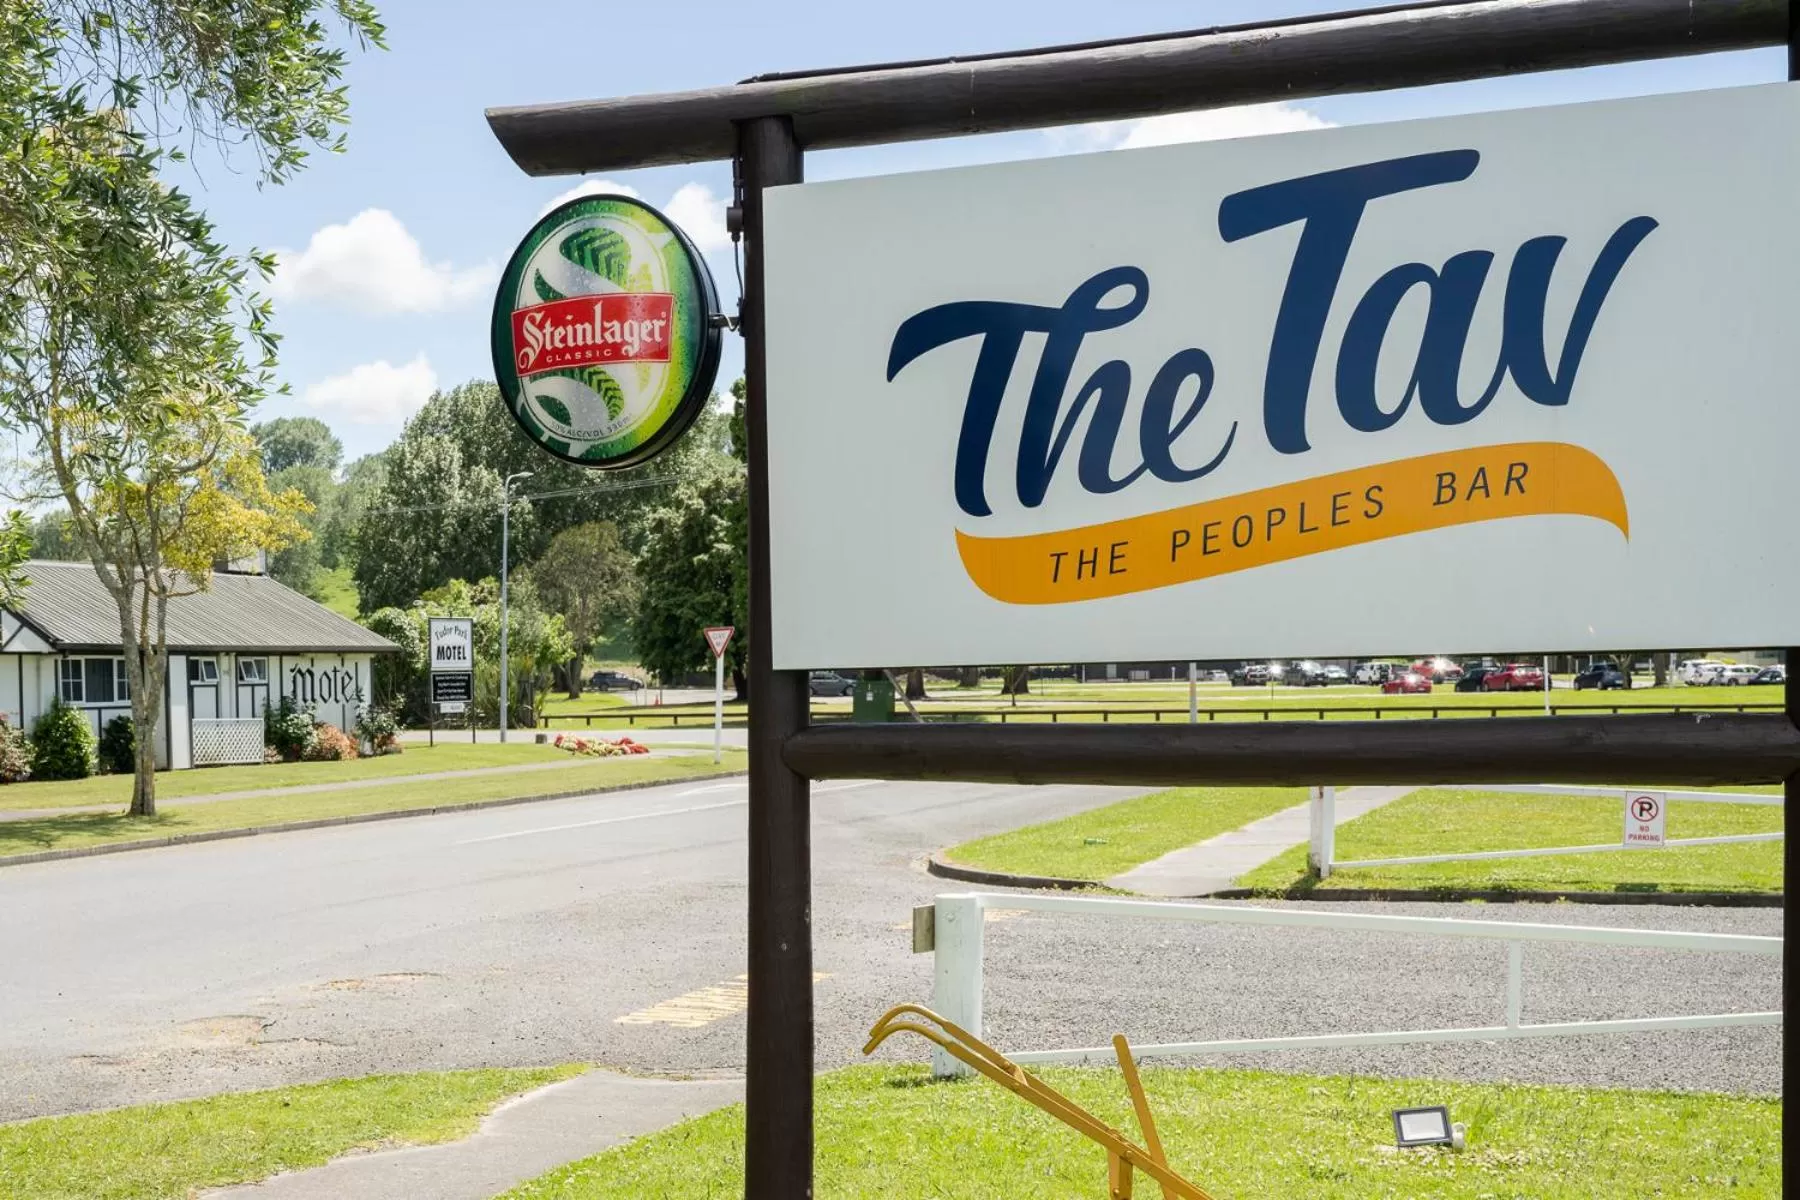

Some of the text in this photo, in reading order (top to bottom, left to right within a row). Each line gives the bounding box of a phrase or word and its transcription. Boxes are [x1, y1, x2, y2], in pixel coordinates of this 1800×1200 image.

[518, 300, 667, 369] Steinlager
[887, 149, 1660, 517] The Tav
[546, 349, 612, 363] CLASSIC
[1050, 462, 1530, 583] THE PEOPLES BAR
[436, 645, 467, 660] MOTEL
[1628, 834, 1660, 842] PARKING
